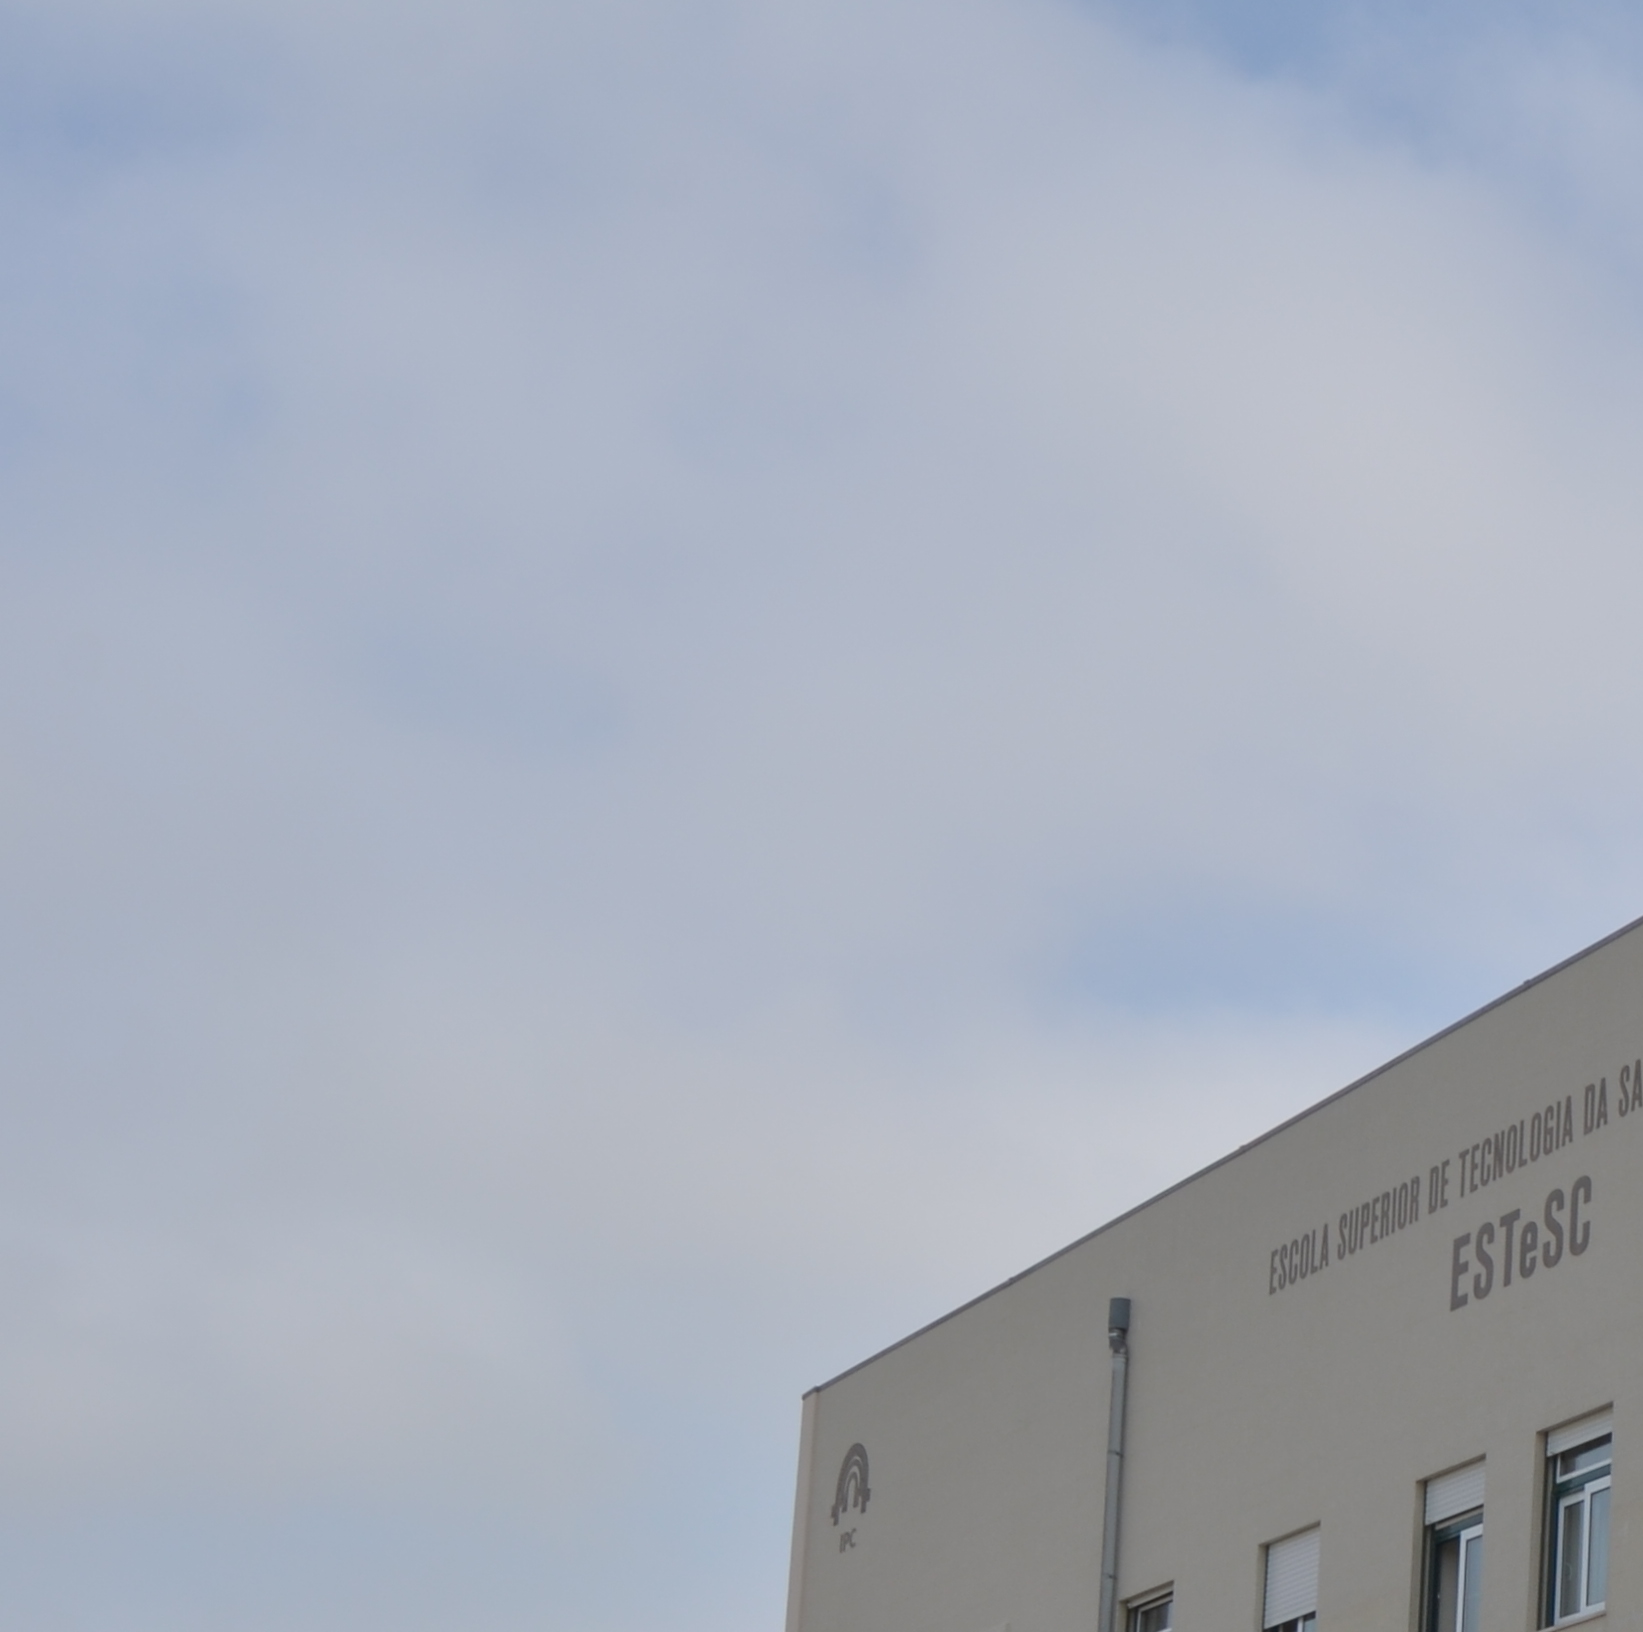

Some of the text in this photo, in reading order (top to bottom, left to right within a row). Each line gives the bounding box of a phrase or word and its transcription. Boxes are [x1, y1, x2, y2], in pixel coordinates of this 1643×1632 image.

[1268, 1223, 1330, 1296] ESCOLA
[1336, 1175, 1421, 1261] SUPERIOR
[1427, 1158, 1451, 1215] DE
[1458, 1094, 1574, 1199] TECNOLOGIA
[1583, 1076, 1609, 1136] DA
[1449, 1174, 1593, 1313] ESTeSC
